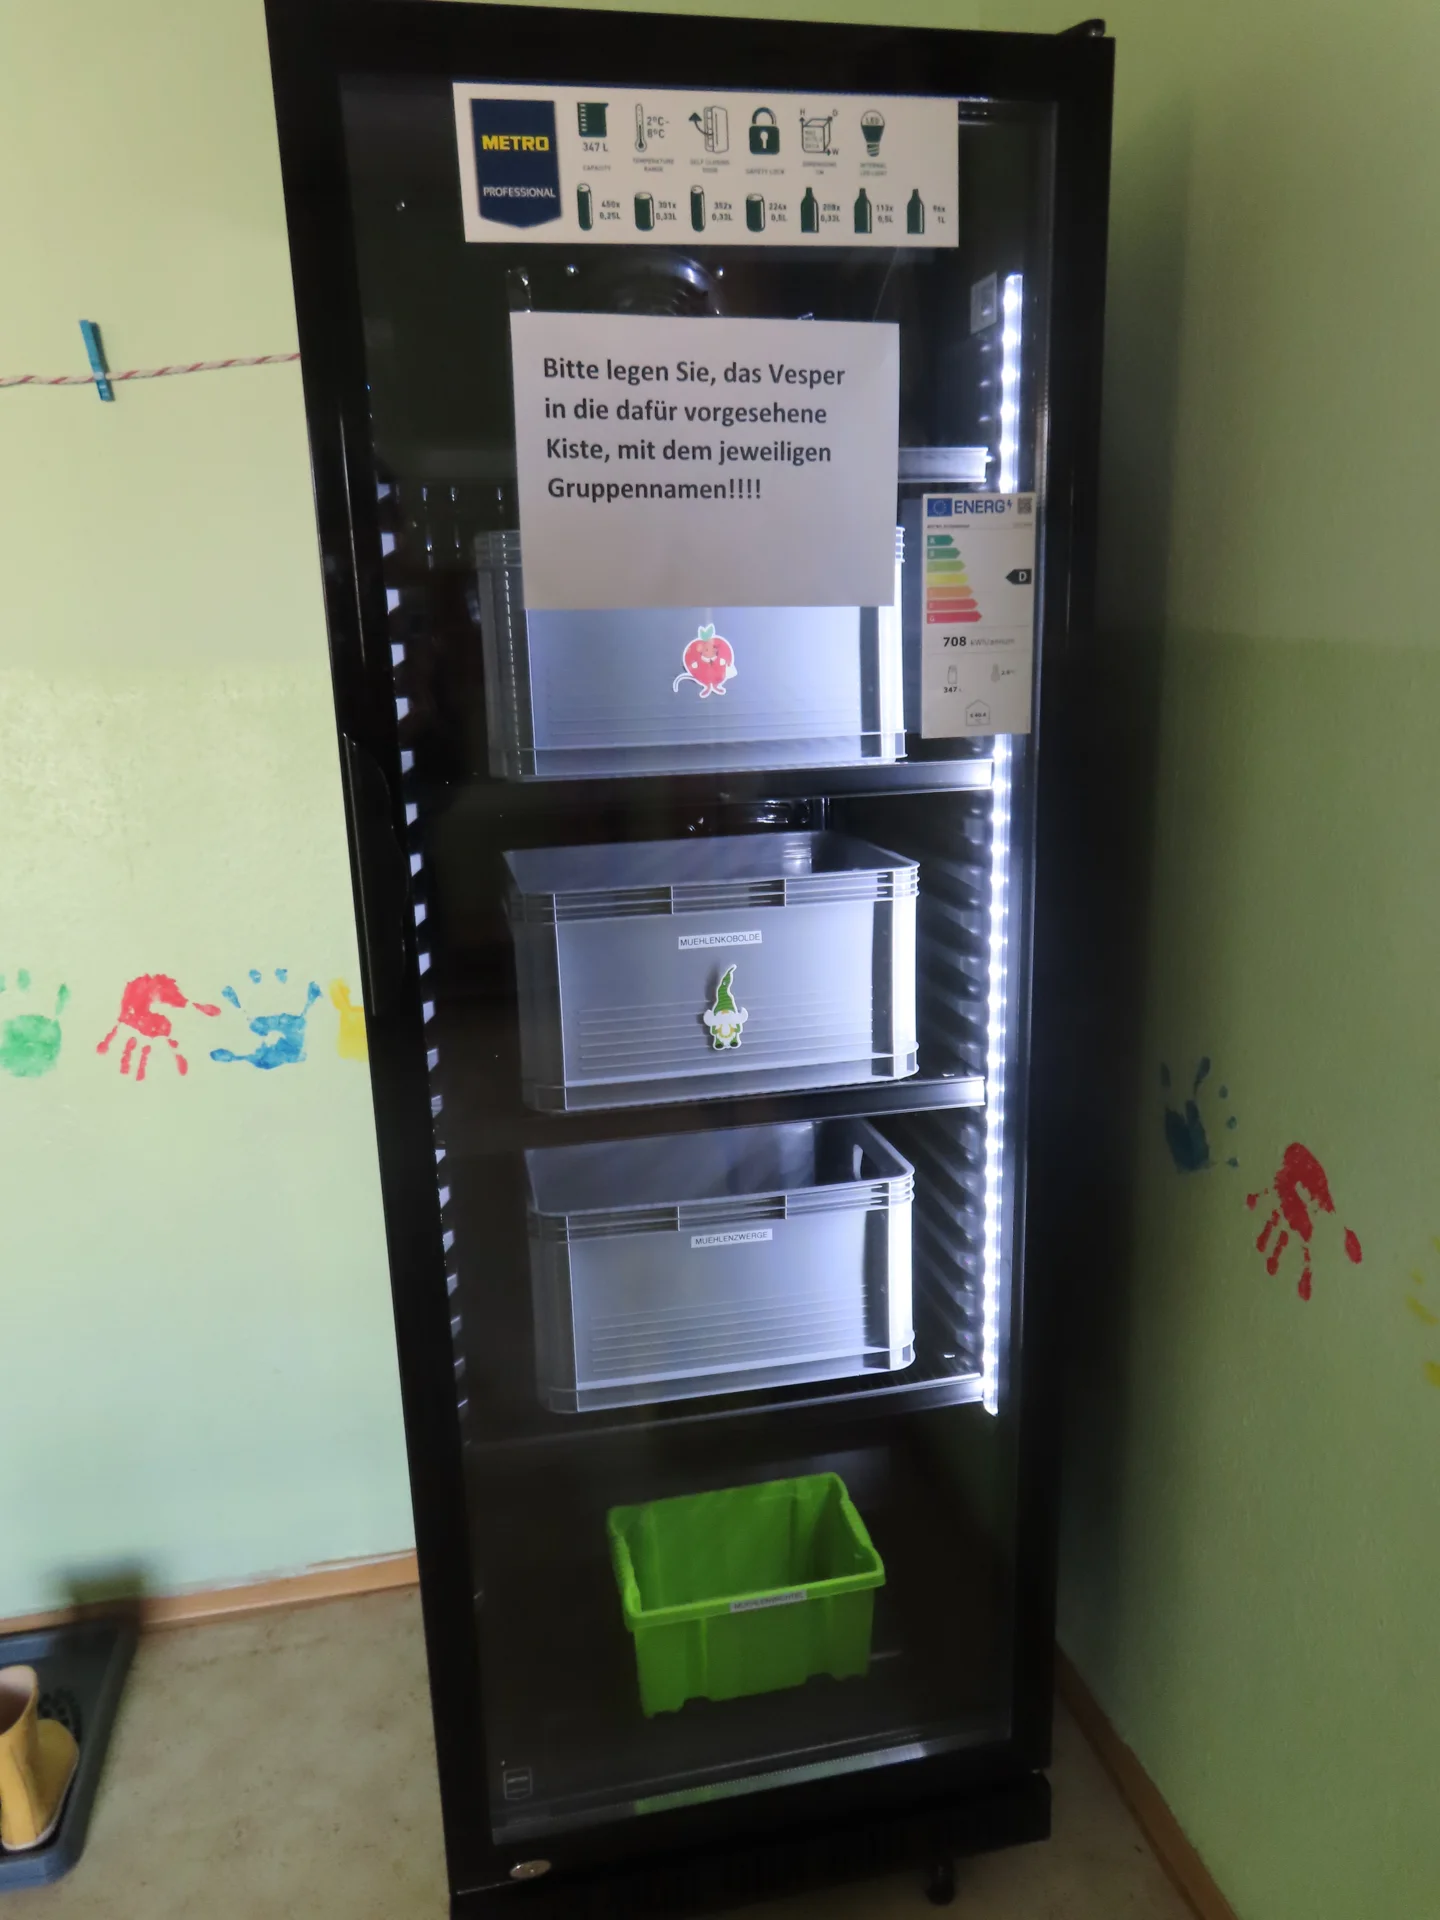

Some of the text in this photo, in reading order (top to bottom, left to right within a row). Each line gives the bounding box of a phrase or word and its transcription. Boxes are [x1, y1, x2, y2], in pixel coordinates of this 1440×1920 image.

[865, 117, 879, 125] LED
[481, 135, 549, 151] METRO
[583, 142, 609, 152] 347 L
[483, 187, 556, 198] PROFESSIONAL
[543, 357, 845, 389] Bitte legen Sie, das Vesper
[545, 397, 827, 427] in die dafür vorgesehene
[546, 438, 831, 466] Kiste, mit dem jeweiligen
[548, 478, 761, 503] Gruppennamen!!!!
[954, 500, 1005, 514] ENERG
[1019, 571, 1027, 582] D
[943, 636, 967, 648] 708
[943, 686, 957, 694] 347
[680, 933, 760, 946] MUEHLENKOBOLDE
[695, 1231, 768, 1245] MUEHLENZWERGE
